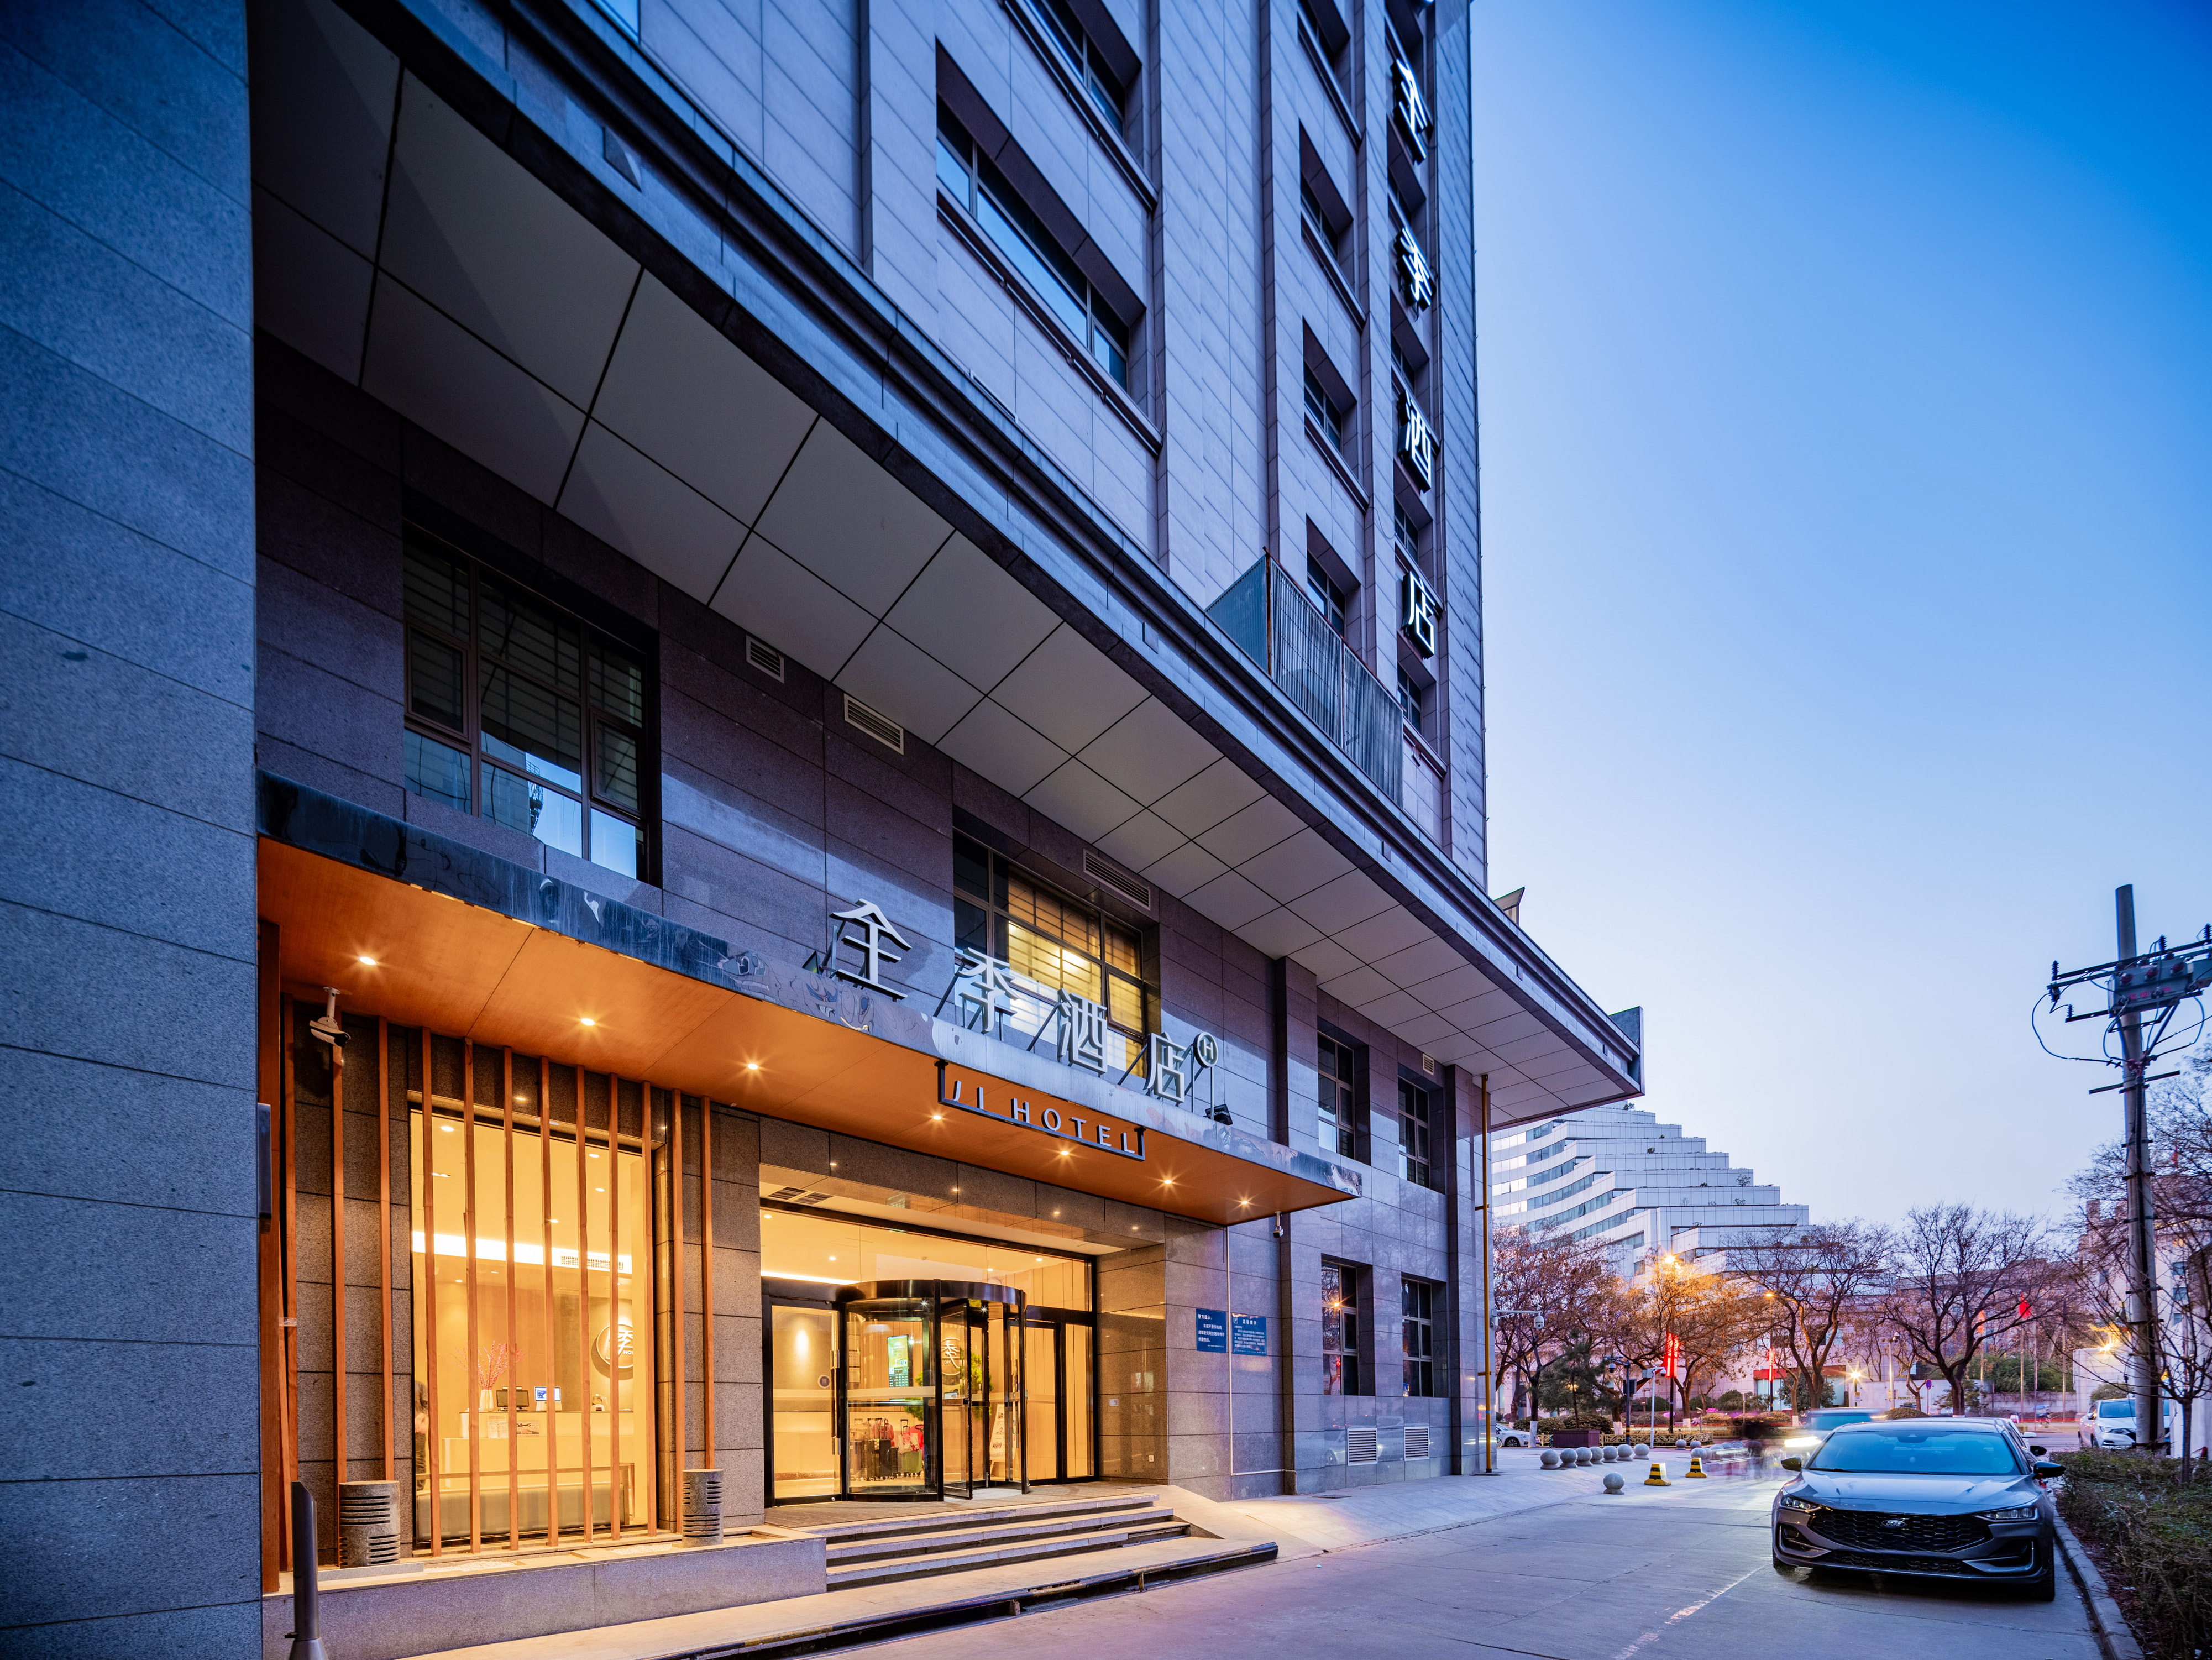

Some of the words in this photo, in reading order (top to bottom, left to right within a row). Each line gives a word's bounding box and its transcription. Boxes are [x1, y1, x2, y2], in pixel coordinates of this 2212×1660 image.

[1396, 57, 1435, 656] 全季酒店
[829, 898, 1186, 1104] 全季酒店
[952, 1080, 984, 1110] JI
[1011, 1097, 1135, 1154] HOTEL
